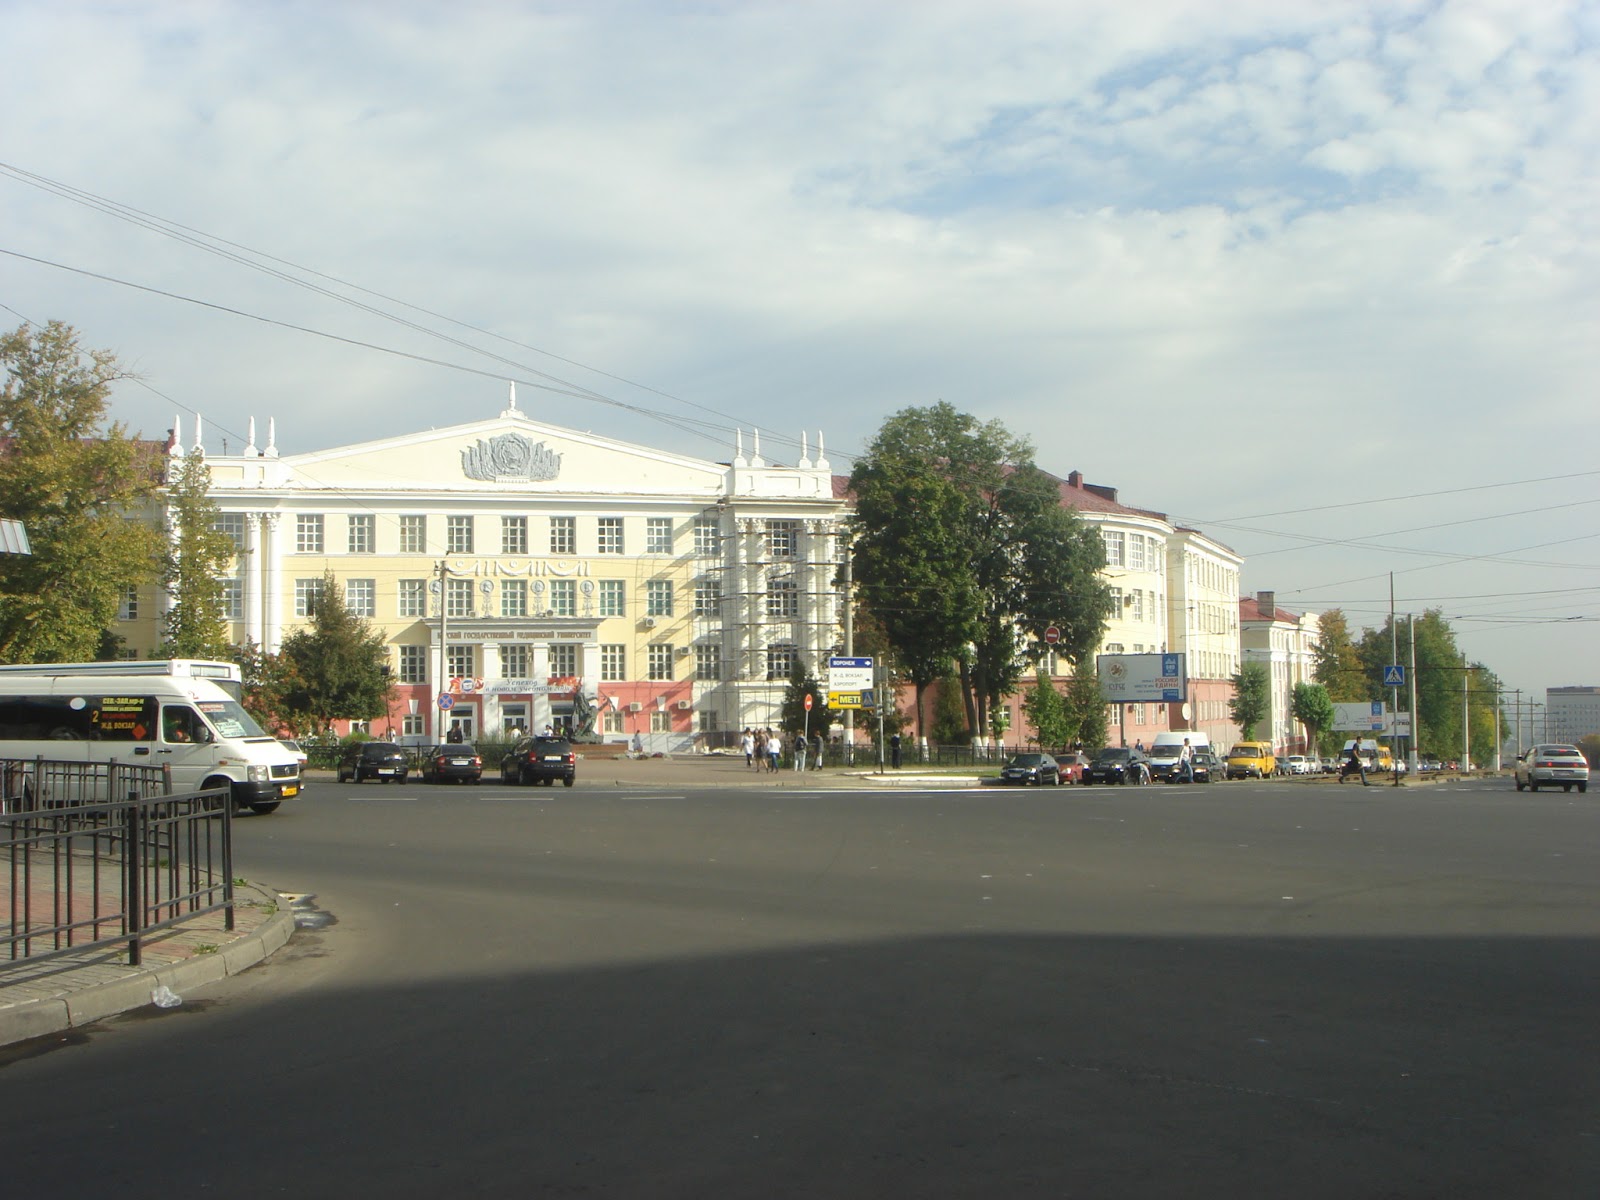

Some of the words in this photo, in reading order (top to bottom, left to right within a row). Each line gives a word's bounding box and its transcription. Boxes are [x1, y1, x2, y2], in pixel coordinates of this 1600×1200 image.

[463, 631, 514, 639] ГОСУДАРСТВЕННЫЙ
[517, 631, 554, 639] МЕДИЦИНСКИЙ
[92, 710, 99, 723] 2
